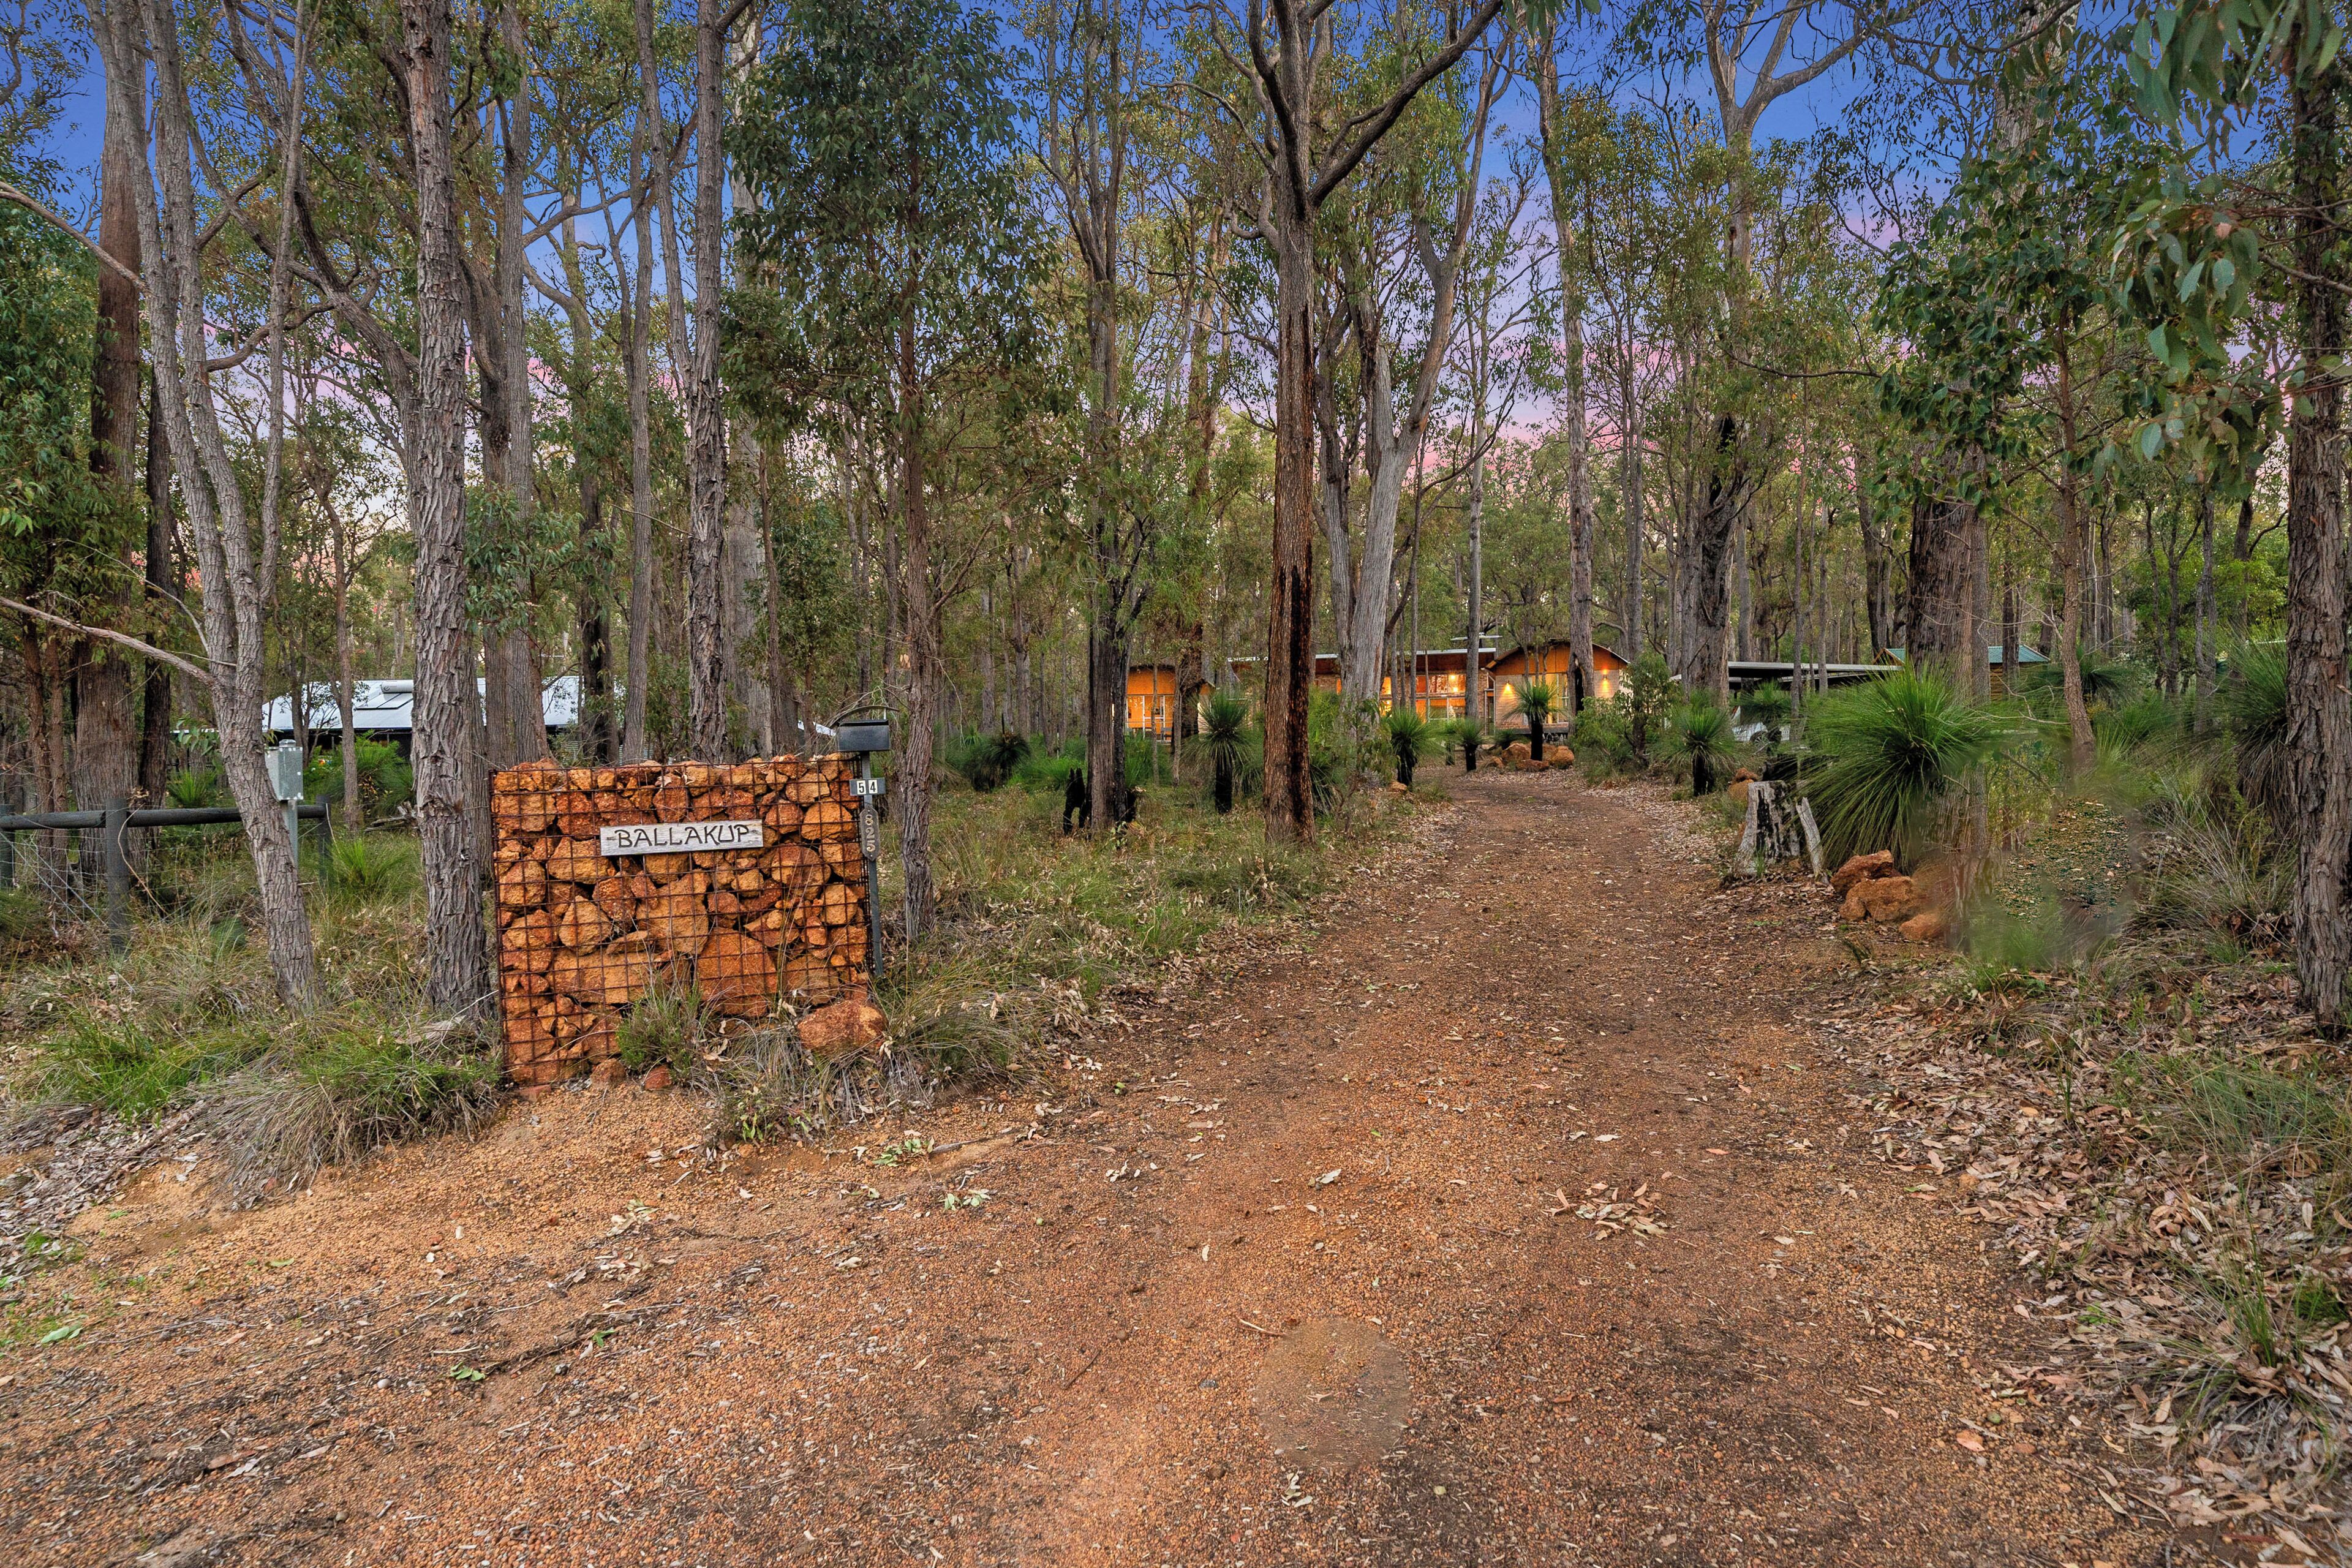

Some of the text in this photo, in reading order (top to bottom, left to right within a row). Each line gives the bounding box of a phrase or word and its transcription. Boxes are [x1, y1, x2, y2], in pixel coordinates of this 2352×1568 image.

[859, 782, 876, 793] 54
[614, 824, 750, 848] BALLAKUP
[865, 814, 875, 852] 825
